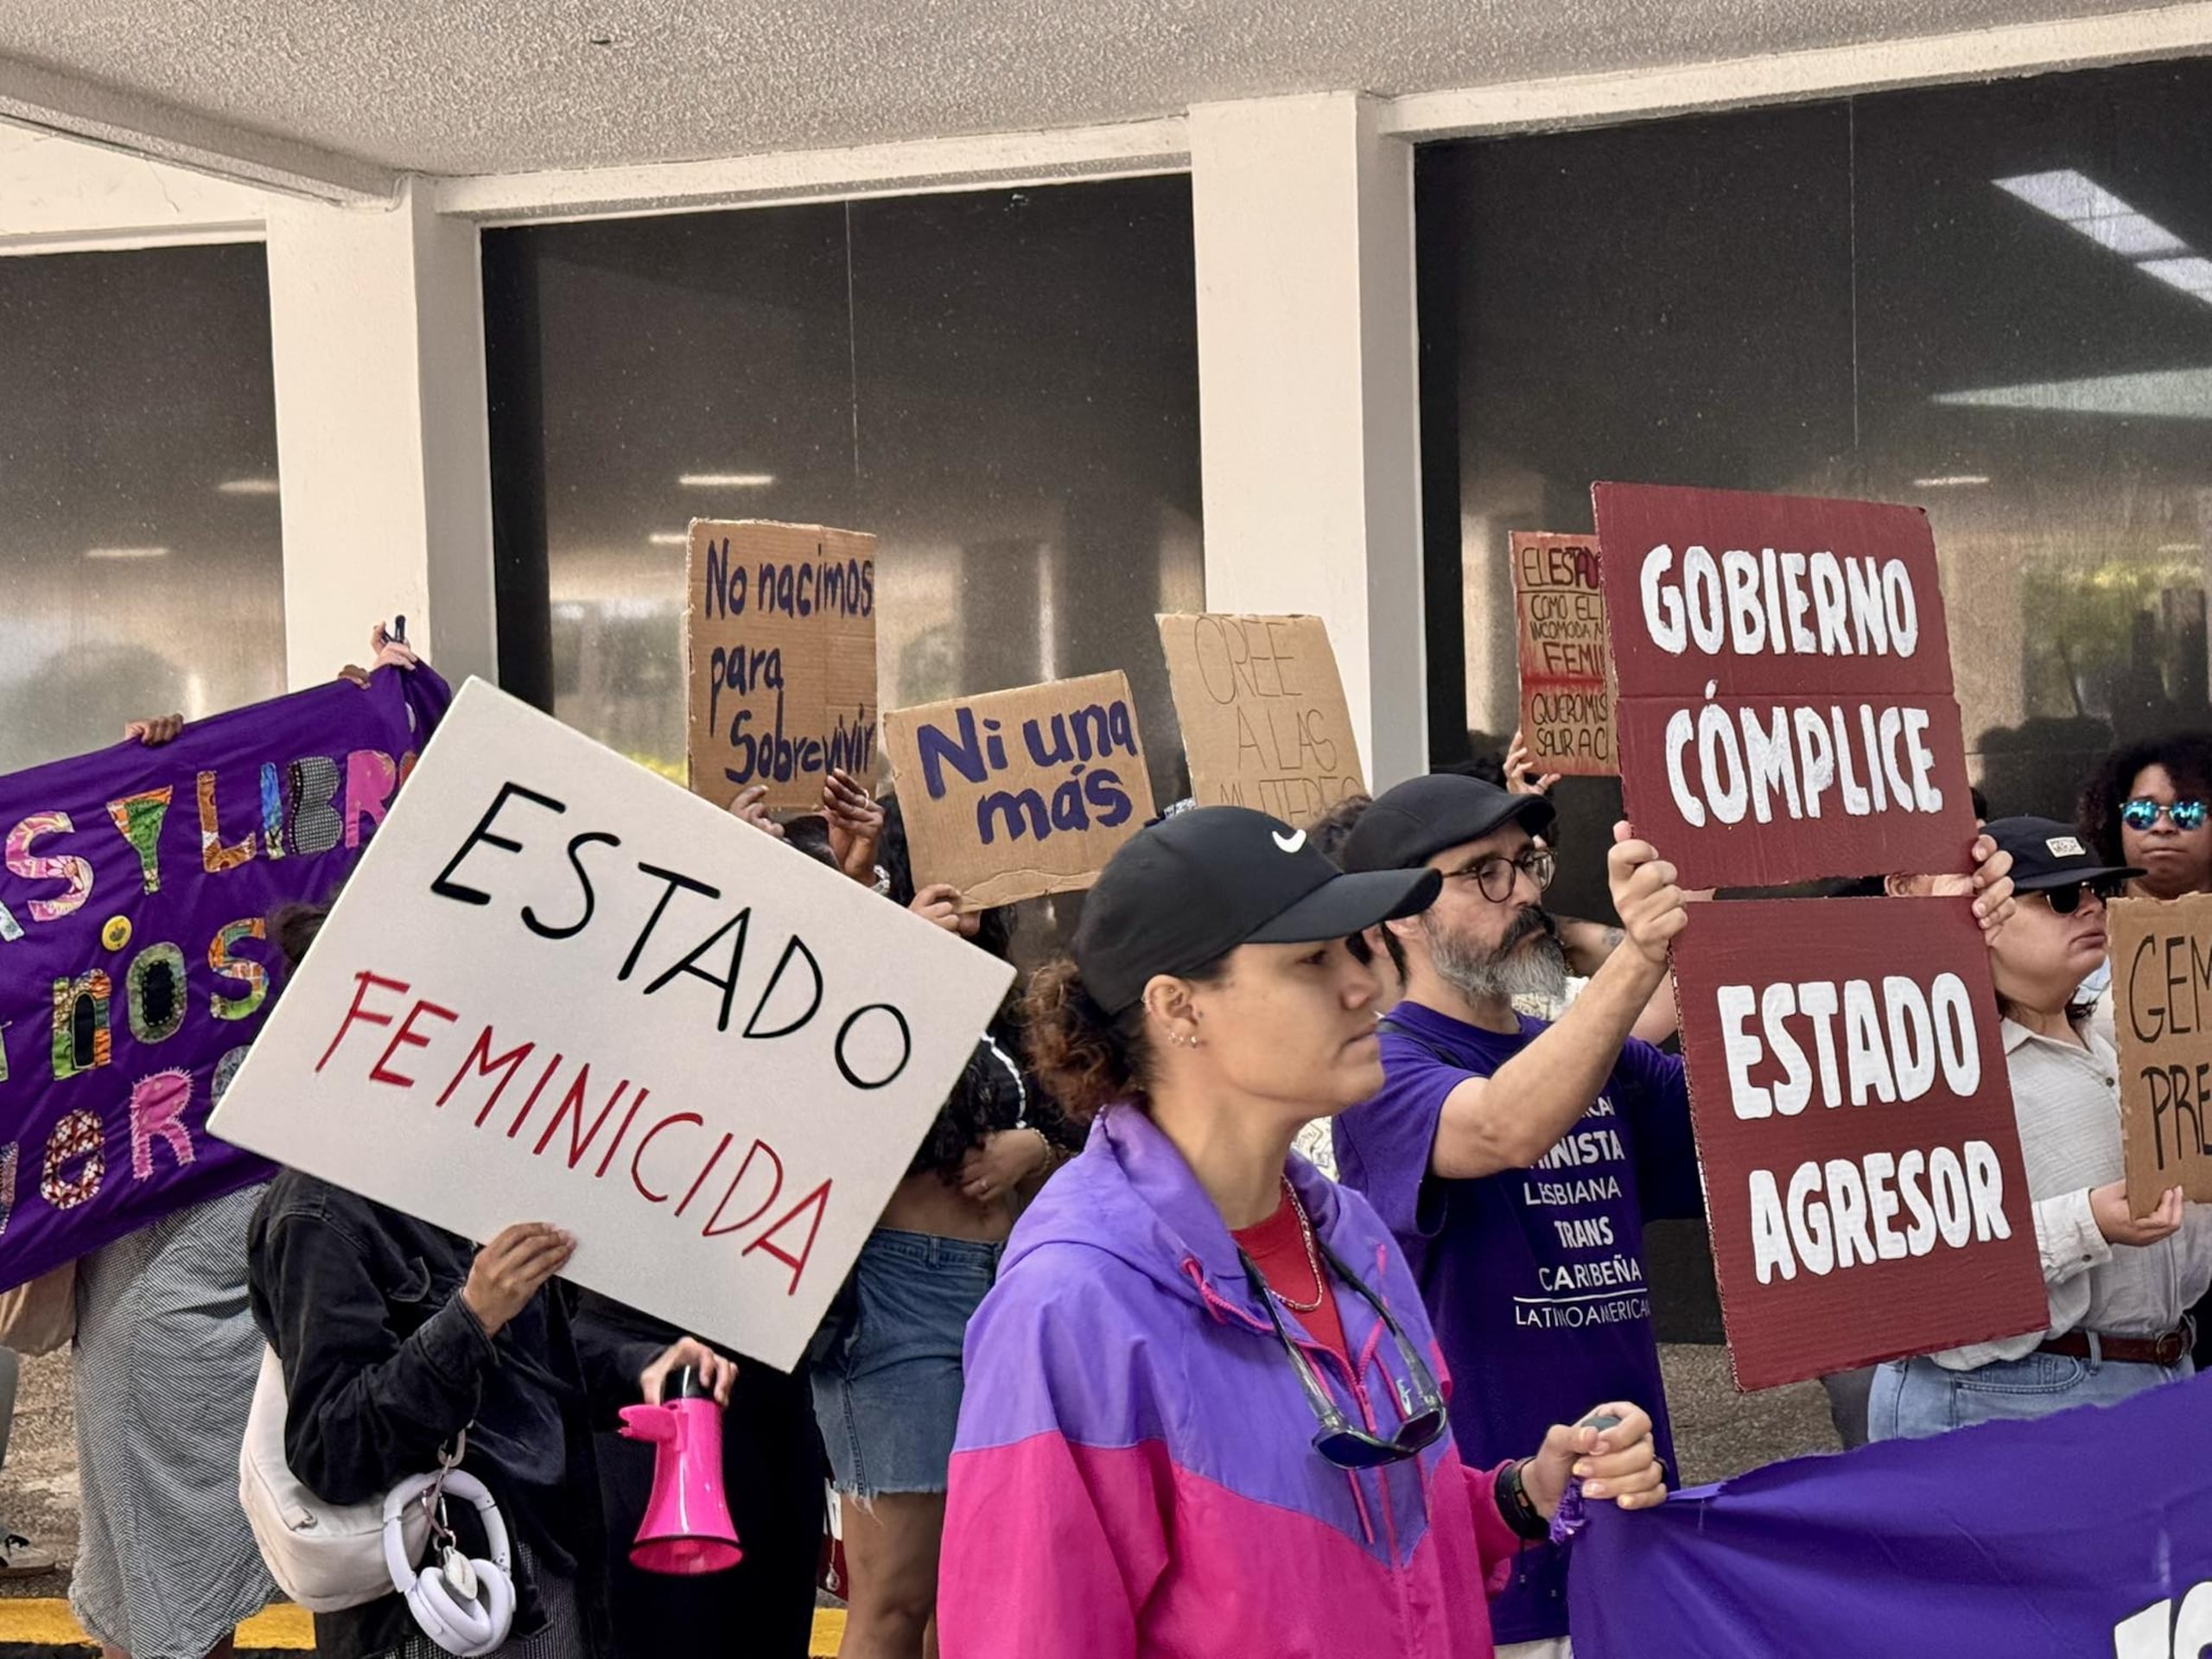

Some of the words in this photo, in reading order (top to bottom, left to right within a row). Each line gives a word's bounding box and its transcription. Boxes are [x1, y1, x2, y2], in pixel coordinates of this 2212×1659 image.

[705, 537, 747, 620] No
[758, 543, 873, 619] nacimos
[1641, 543, 1918, 658] GOBIERNO
[710, 644, 785, 738] para
[724, 690, 876, 785] Sobrevivir
[917, 707, 1008, 801] Ni
[1023, 700, 1138, 768] una
[1666, 679, 1943, 827] CÓMPLICE
[105, 785, 173, 895] Y
[976, 763, 1133, 845] más
[430, 781, 912, 1090] ESTADO
[1716, 972, 1981, 1120] ESTADO
[315, 969, 834, 1296] FEMINICIDA
[1523, 1176, 1622, 1205] LESBIANA
[1554, 1216, 1614, 1248] TRANS
[1749, 1141, 2012, 1285] AGRESOR
[1539, 1254, 1643, 1291] CARIBEÑA
